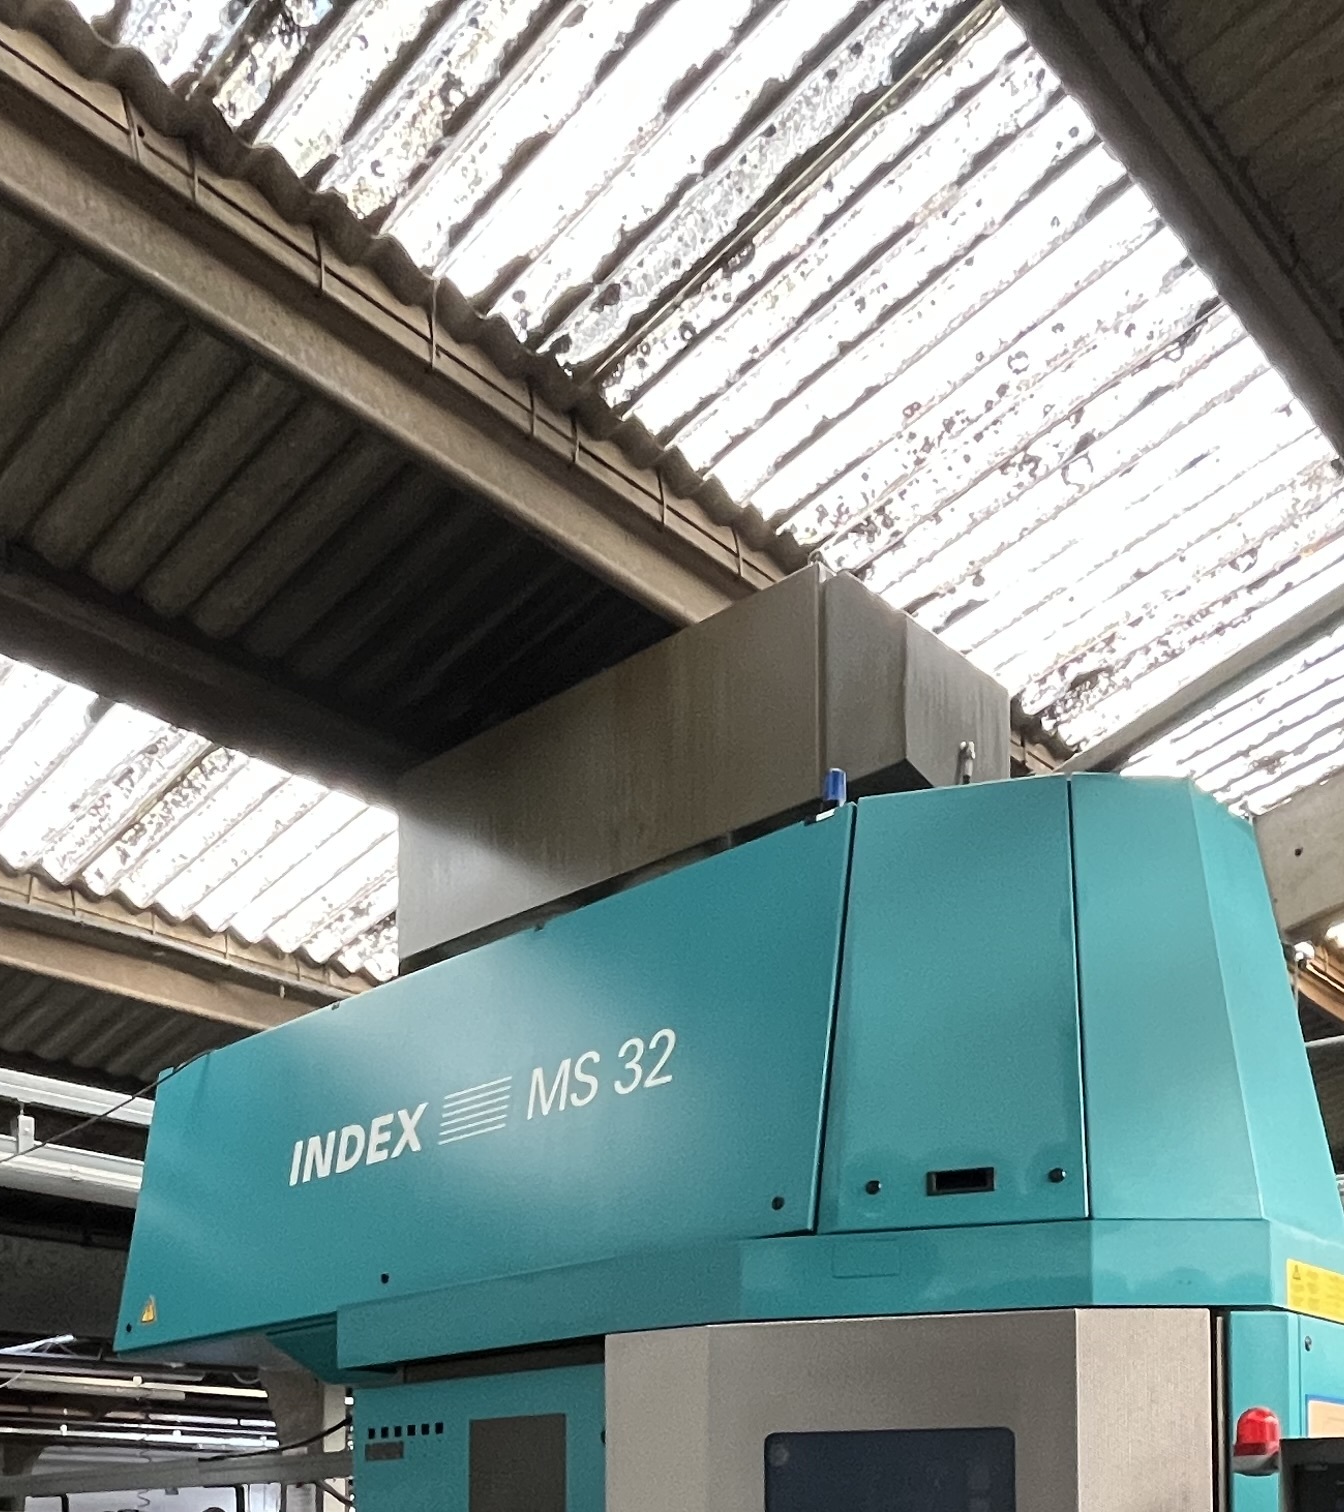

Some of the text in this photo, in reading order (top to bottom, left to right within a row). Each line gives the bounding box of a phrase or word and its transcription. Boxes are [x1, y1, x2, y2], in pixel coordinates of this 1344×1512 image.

[288, 1028, 677, 1187] INDEX MS 32
